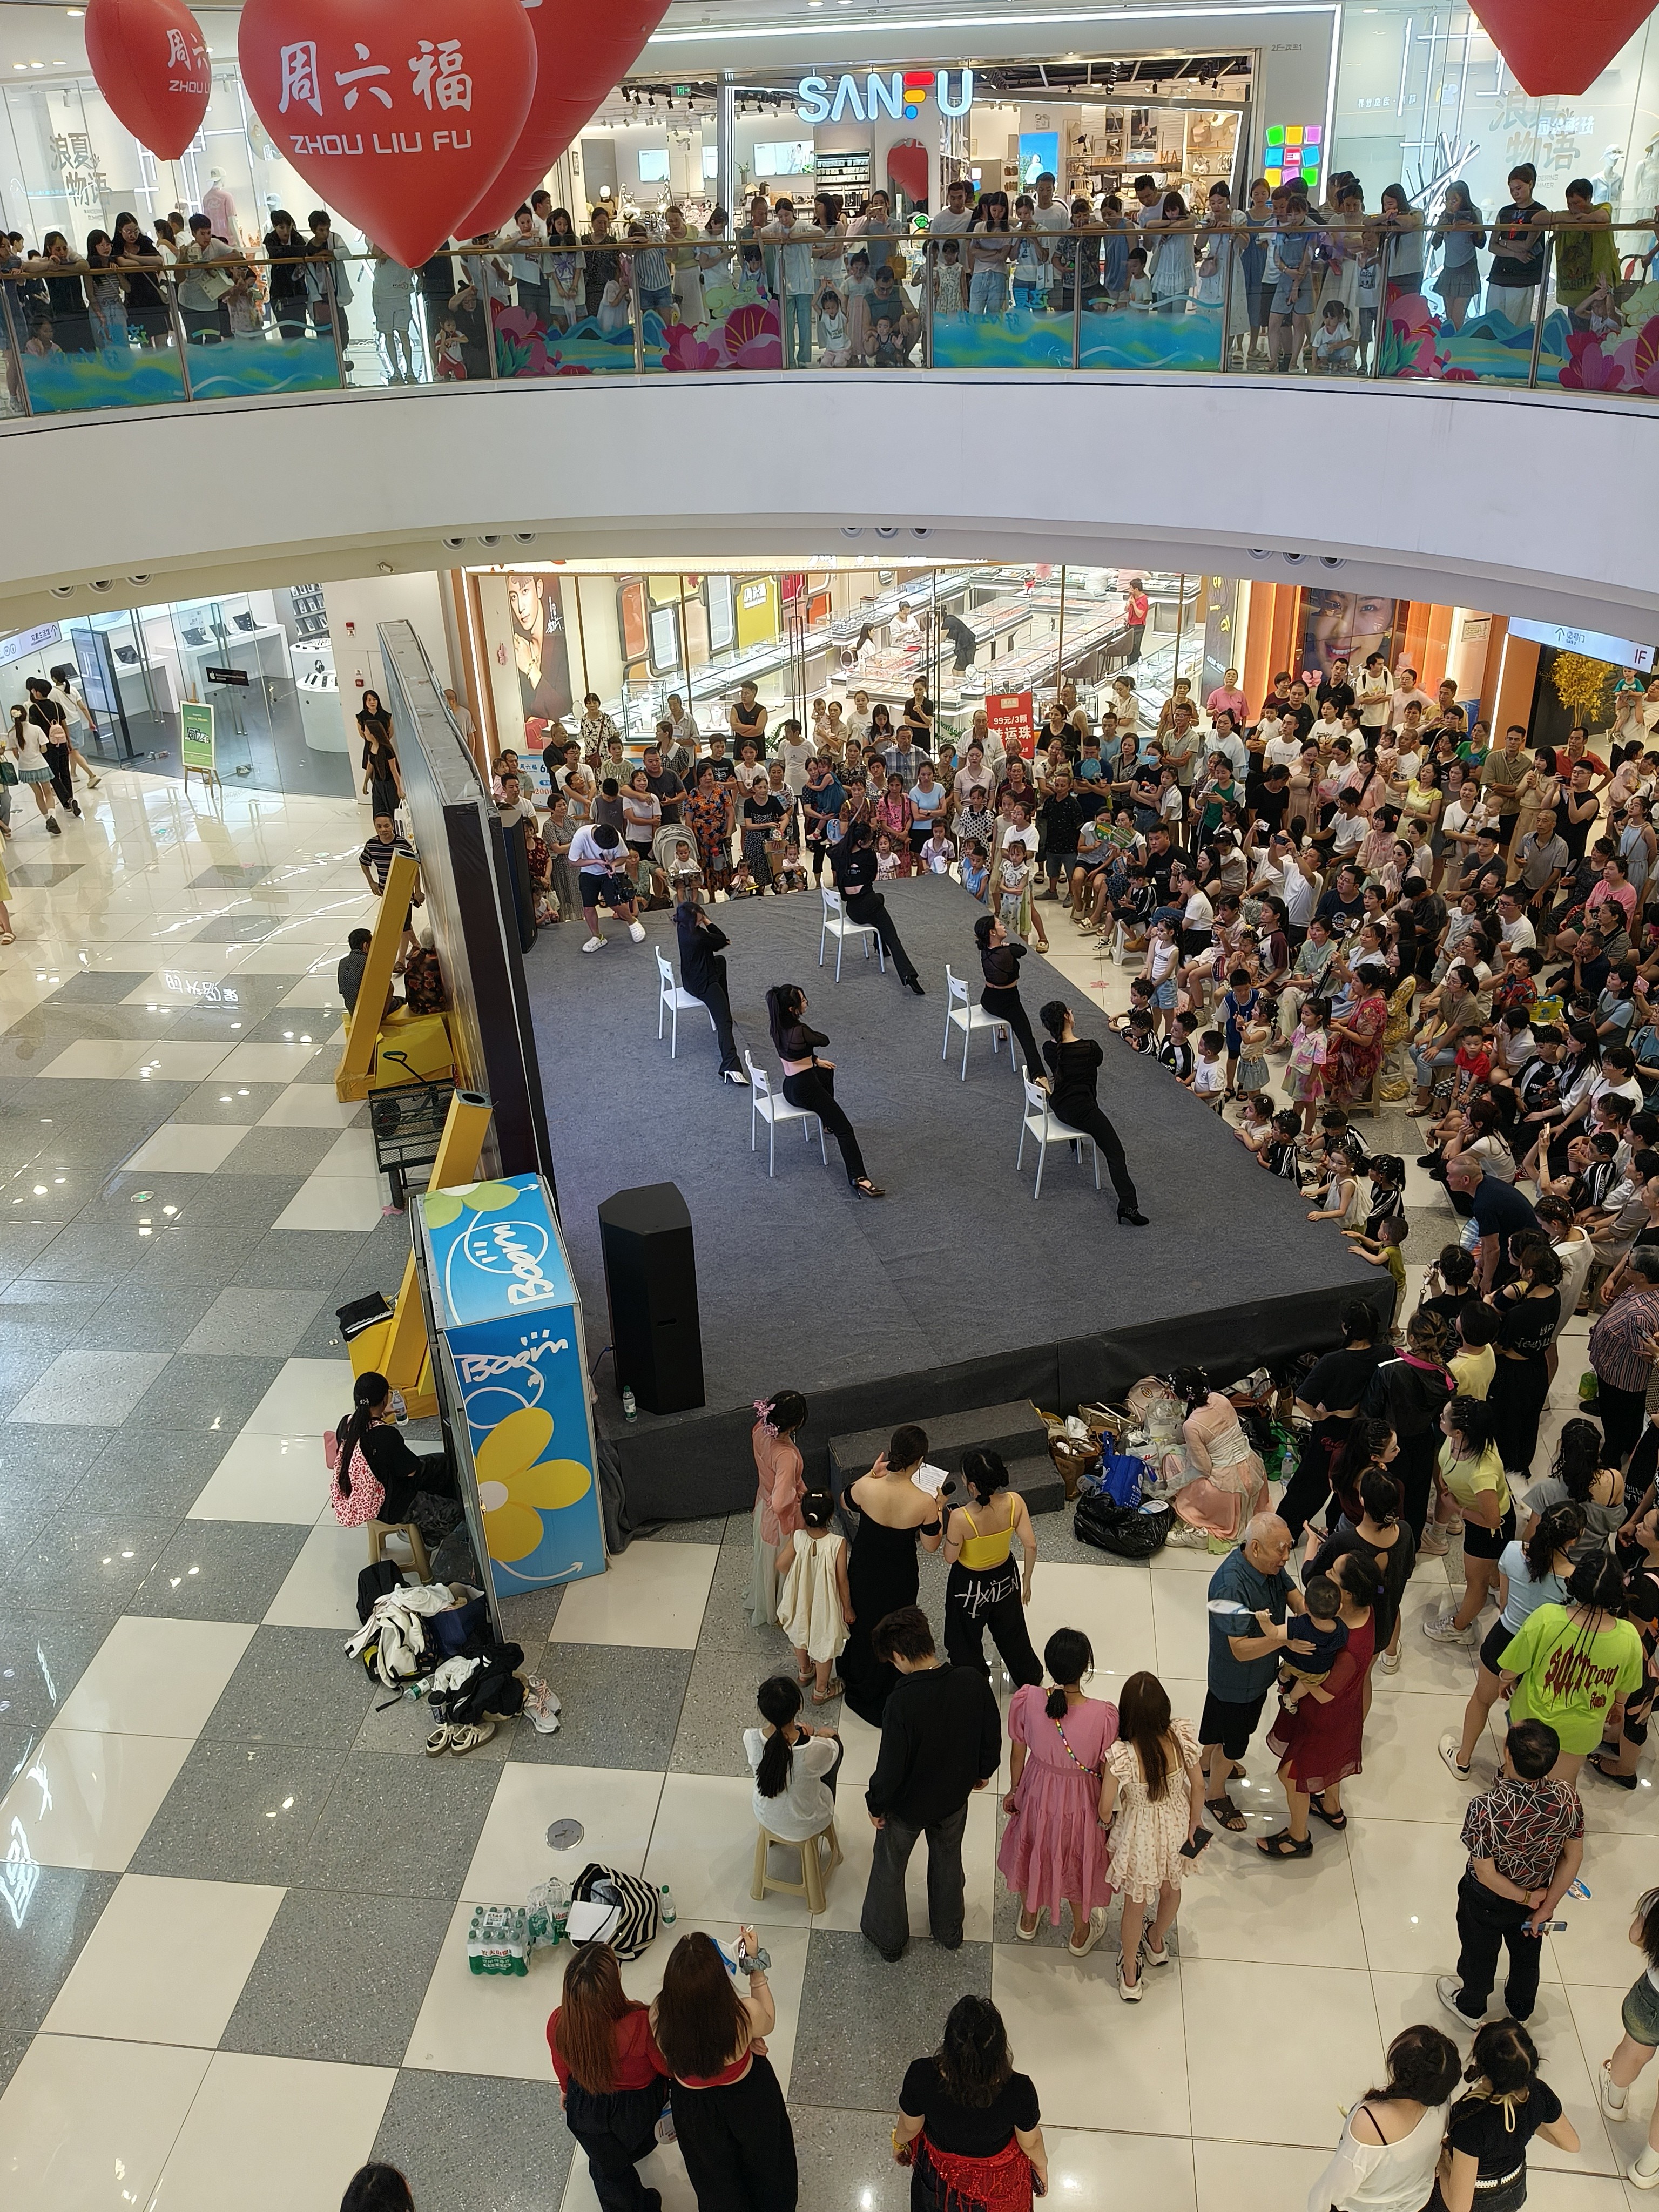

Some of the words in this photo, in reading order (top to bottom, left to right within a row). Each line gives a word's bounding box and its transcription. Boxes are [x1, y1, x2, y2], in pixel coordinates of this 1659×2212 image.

[166, 29, 208, 71] 周六
[169, 80, 203, 93] ZHOU
[278, 38, 473, 116] 周六福
[798, 69, 973, 123] SANFU
[290, 134, 363, 155] ZHOU
[373, 132, 422, 153] LIU
[433, 129, 472, 151] FU
[1634, 649, 1648, 664] IF
[994, 714, 1028, 725] 99元/3颗
[493, 1224, 555, 1305] Boom
[461, 1338, 568, 1384] Boom
